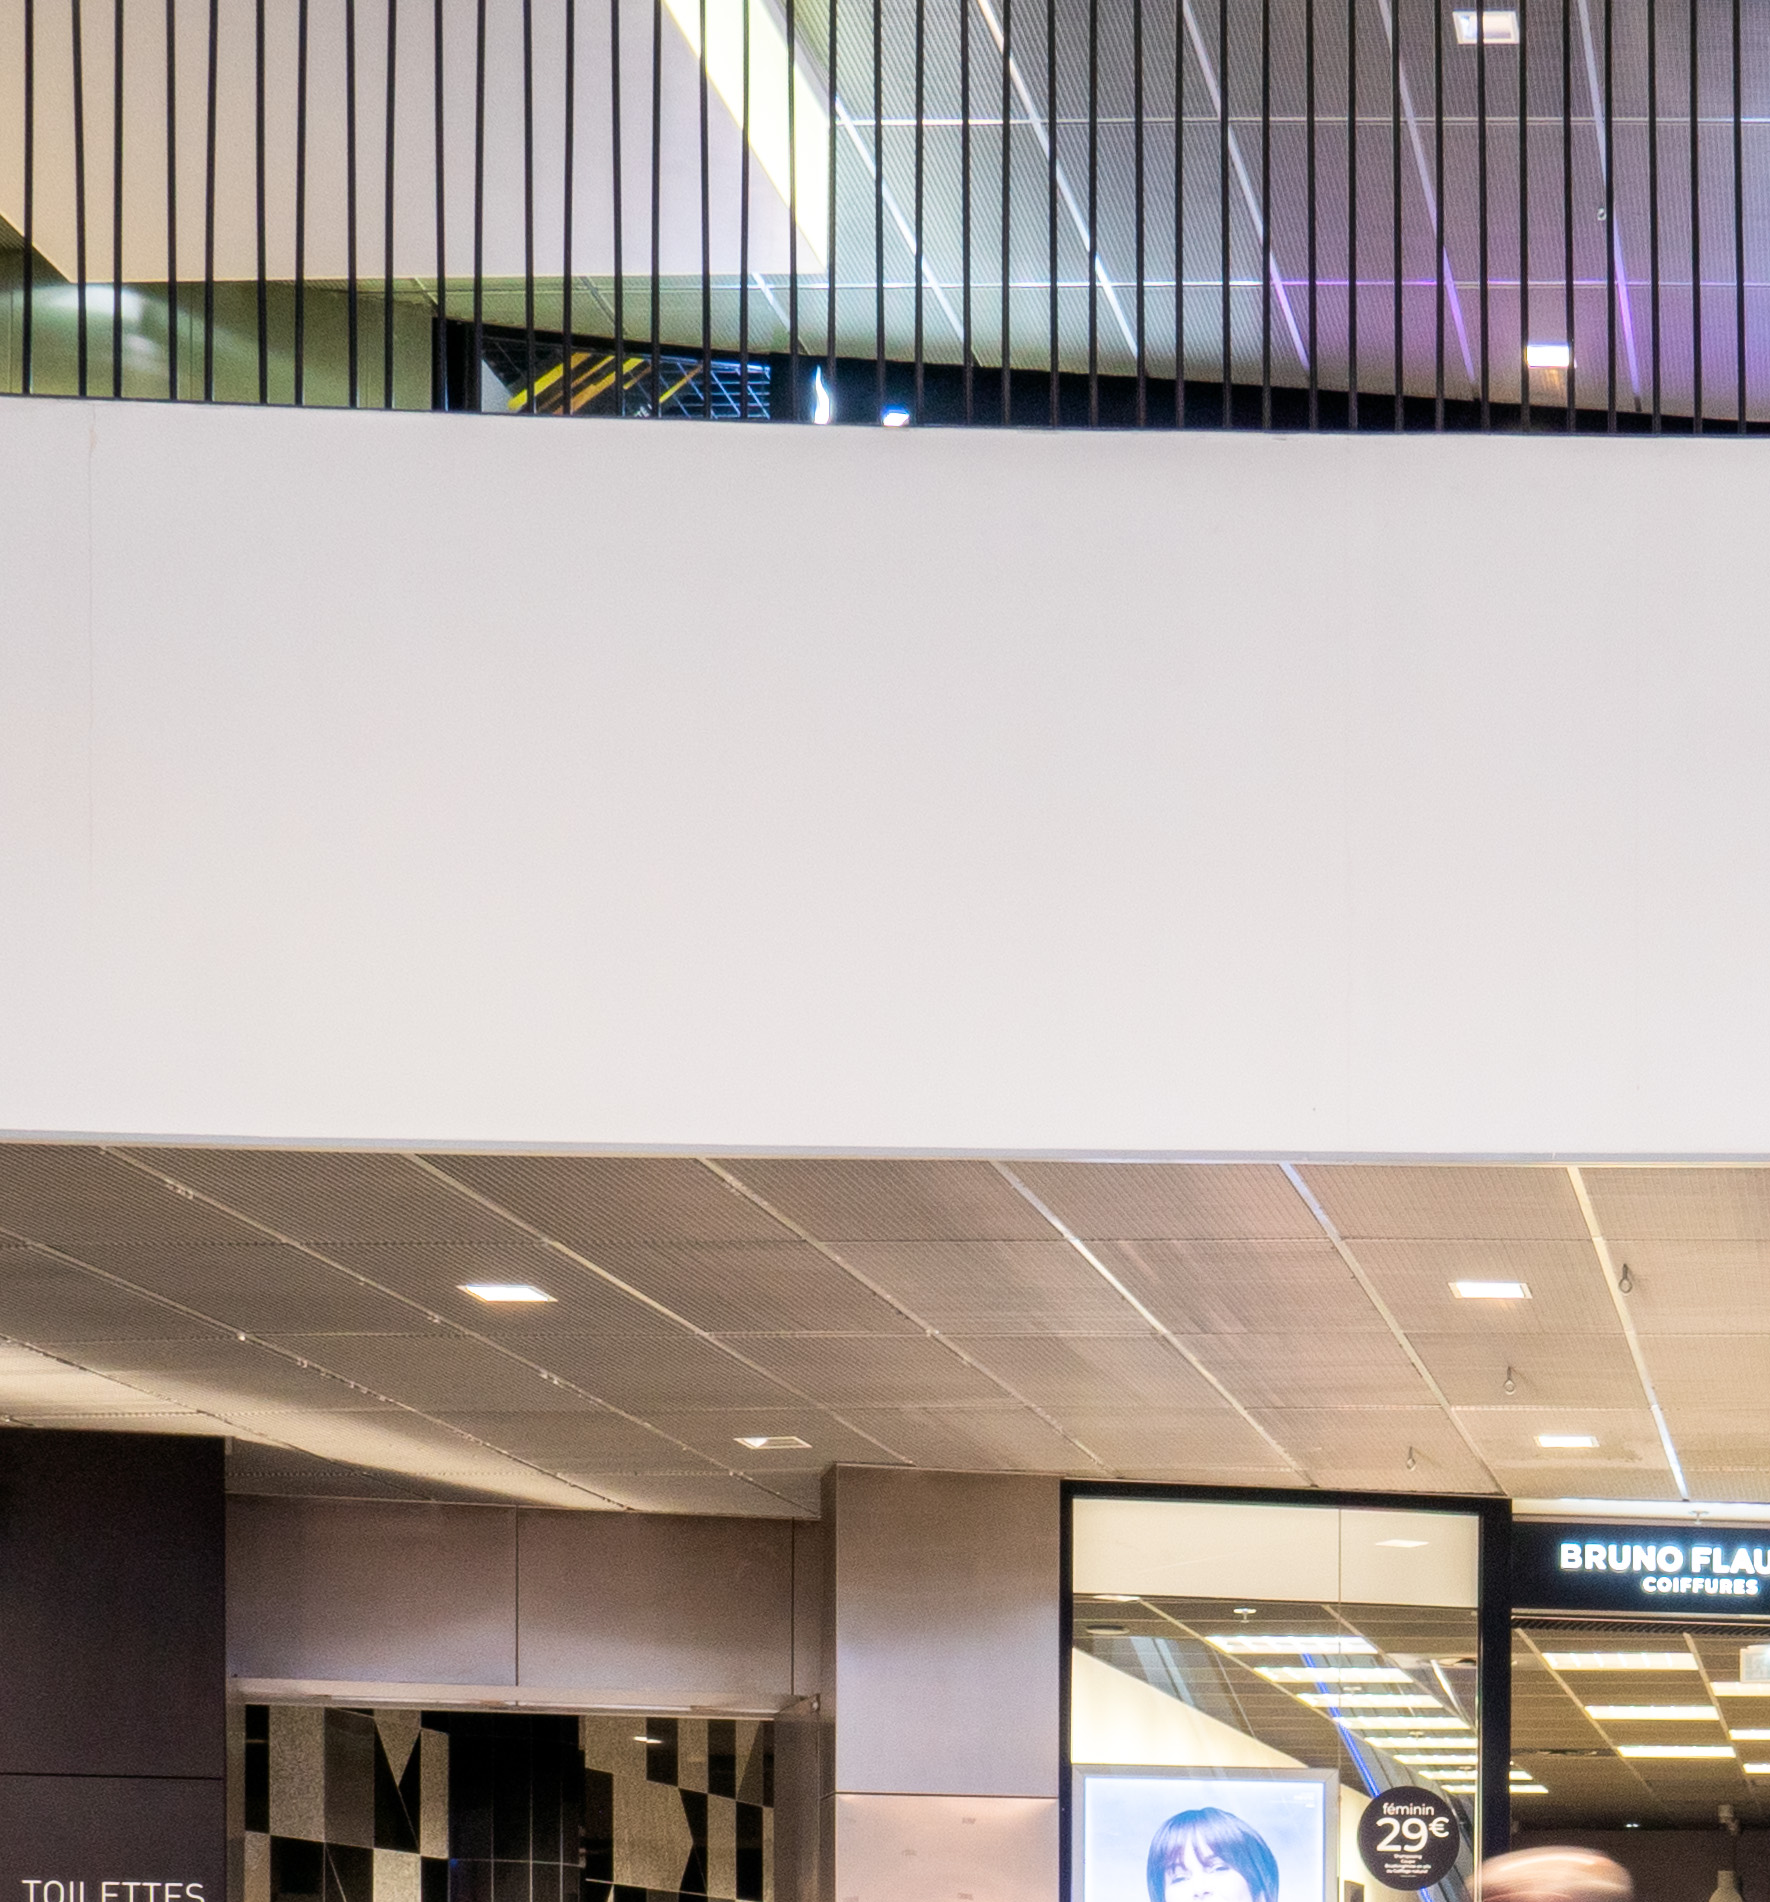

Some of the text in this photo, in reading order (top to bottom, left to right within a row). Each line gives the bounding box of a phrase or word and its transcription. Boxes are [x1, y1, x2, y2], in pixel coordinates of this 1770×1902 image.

[1559, 1543, 1684, 1573] BRUNO
[1642, 1575, 1759, 1595] COIFFURES
[1382, 1803, 1436, 1816] féminin
[1375, 1816, 1450, 1853] 29€
